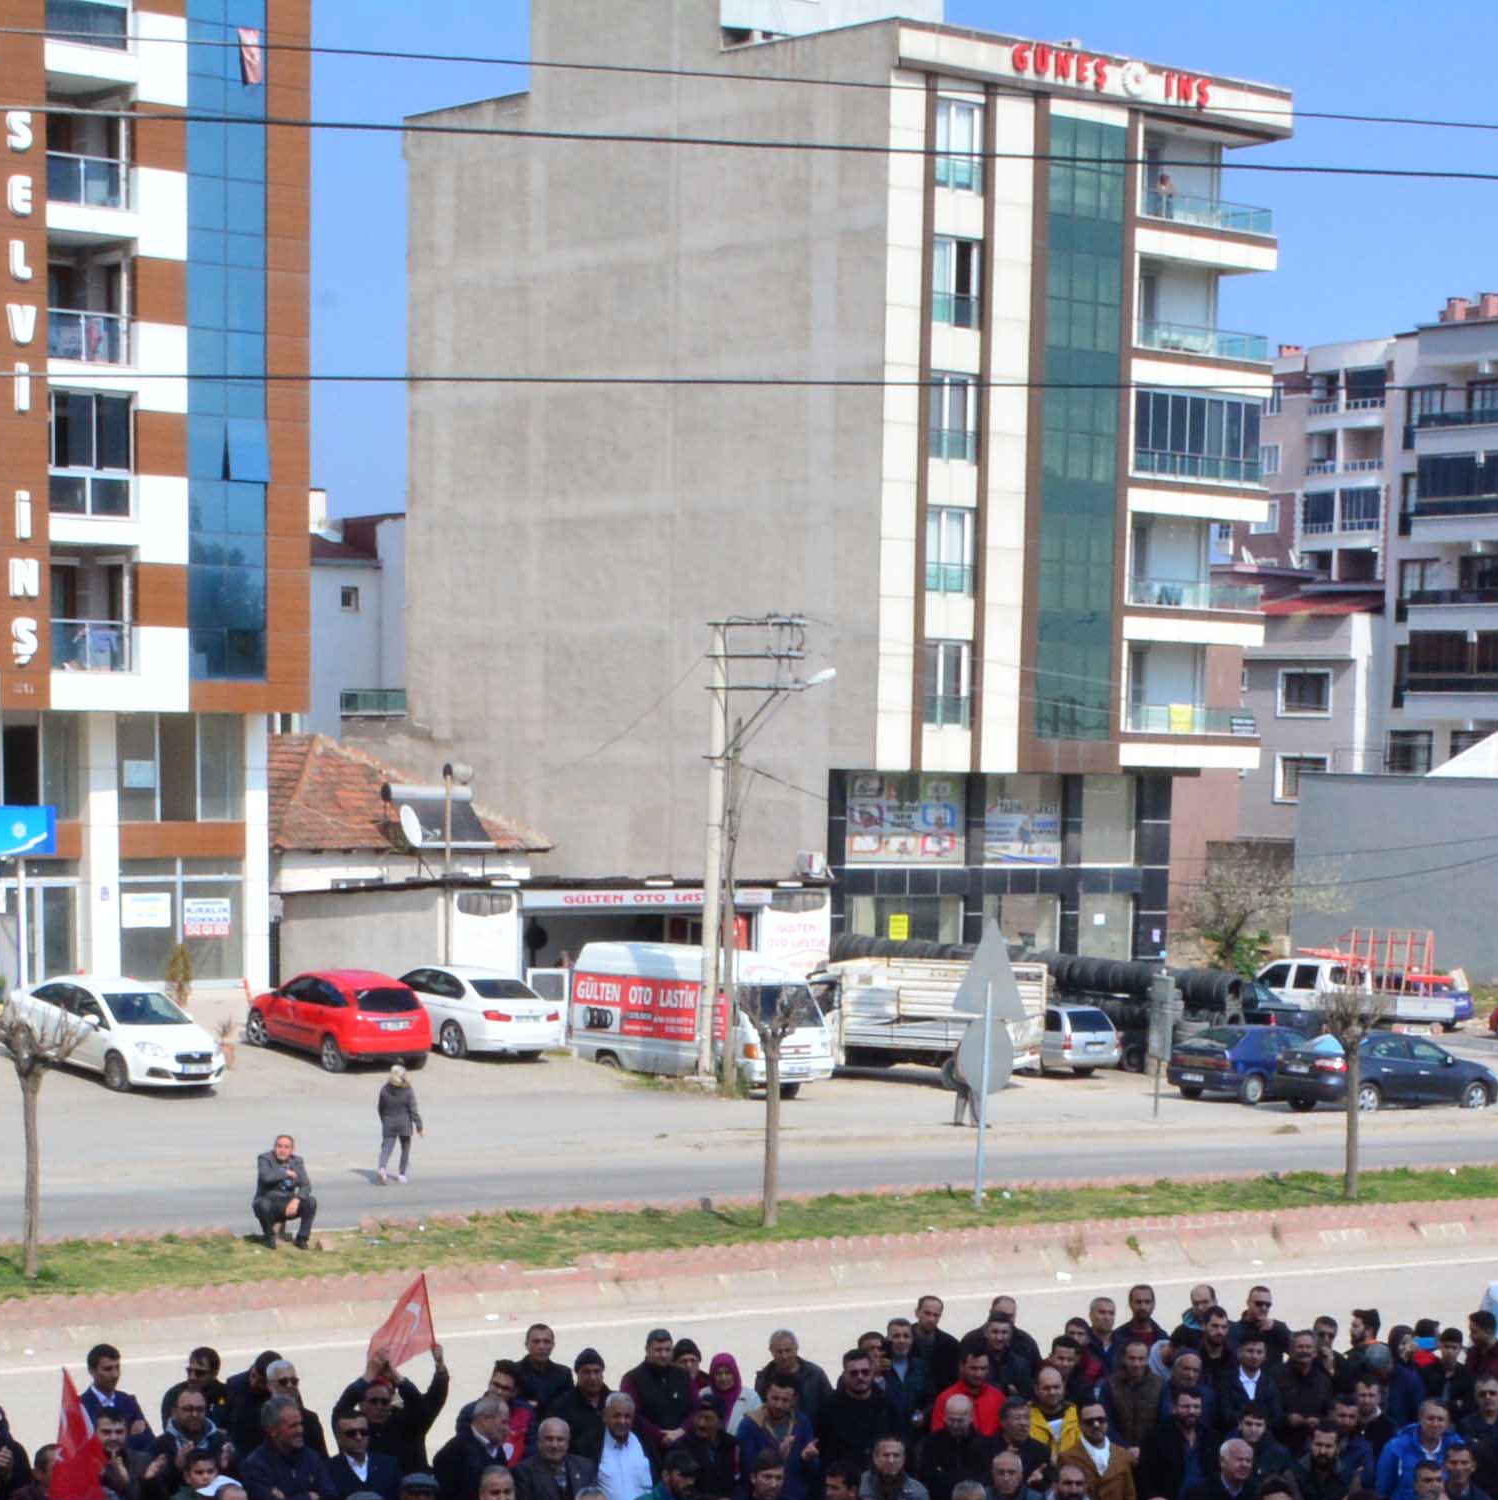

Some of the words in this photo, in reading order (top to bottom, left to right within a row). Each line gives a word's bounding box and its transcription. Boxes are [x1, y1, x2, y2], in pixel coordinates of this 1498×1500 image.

[674, 892, 702, 903] LAS
[576, 976, 621, 1002] GÜLTEN
[628, 987, 652, 1005] OTO
